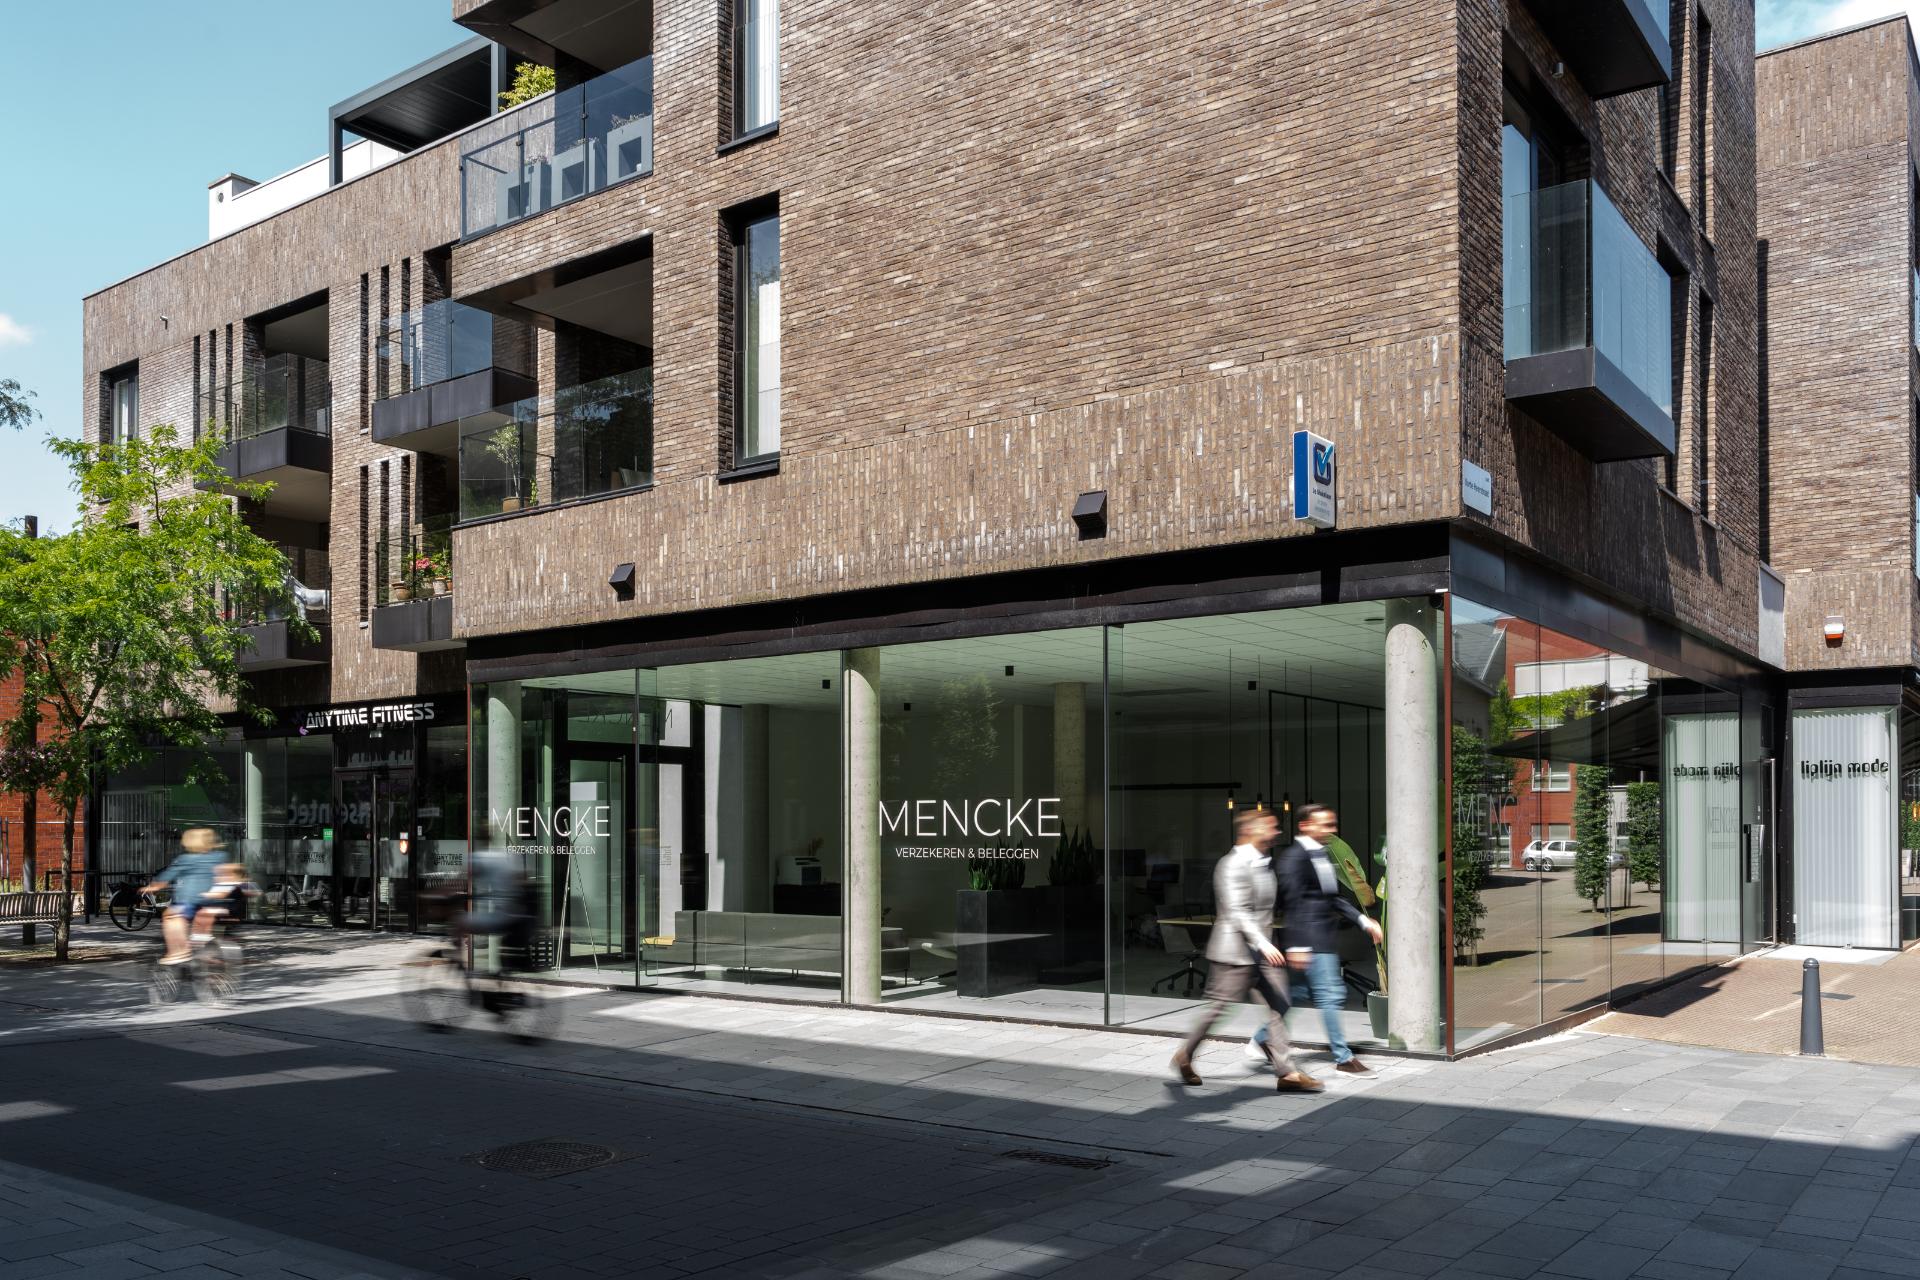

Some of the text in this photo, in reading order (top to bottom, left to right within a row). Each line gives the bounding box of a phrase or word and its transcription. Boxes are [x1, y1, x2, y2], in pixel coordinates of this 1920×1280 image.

[305, 702, 435, 729] ANYTIME FITNESS
[1800, 758, 1889, 779] liplijn mode
[492, 806, 611, 837] MENCKE
[879, 798, 1061, 837] MENCKE
[1458, 792, 1537, 838] MENC
[550, 845, 556, 855] &
[556, 845, 596, 855] BELEGGEN
[895, 847, 1039, 860] VERZEKEREN & BELEGGEN
